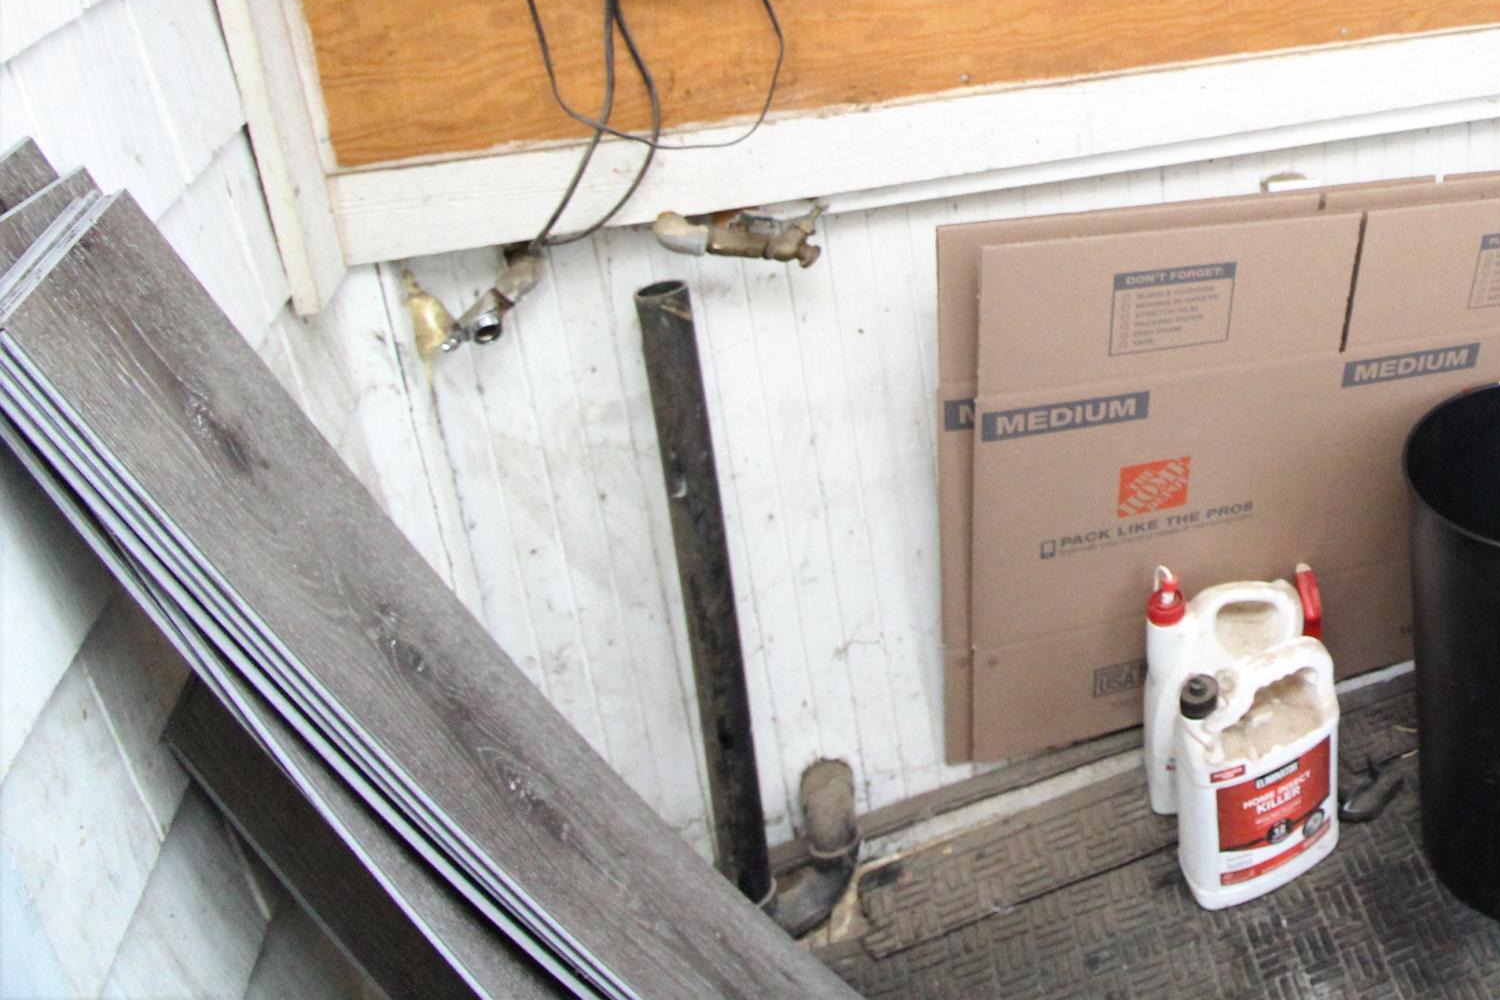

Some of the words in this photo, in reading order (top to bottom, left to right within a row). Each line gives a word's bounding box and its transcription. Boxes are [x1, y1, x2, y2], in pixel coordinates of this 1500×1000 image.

[1125, 272, 1166, 285] DON'T
[1354, 349, 1468, 382] MEDIUM
[995, 398, 1137, 436] MEDIUM
[1060, 529, 1110, 547] PACK
[1117, 519, 1159, 536] LIKE
[1167, 512, 1200, 527] THE
[1206, 501, 1253, 519] PROS
[1255, 784, 1301, 814] KILLER
